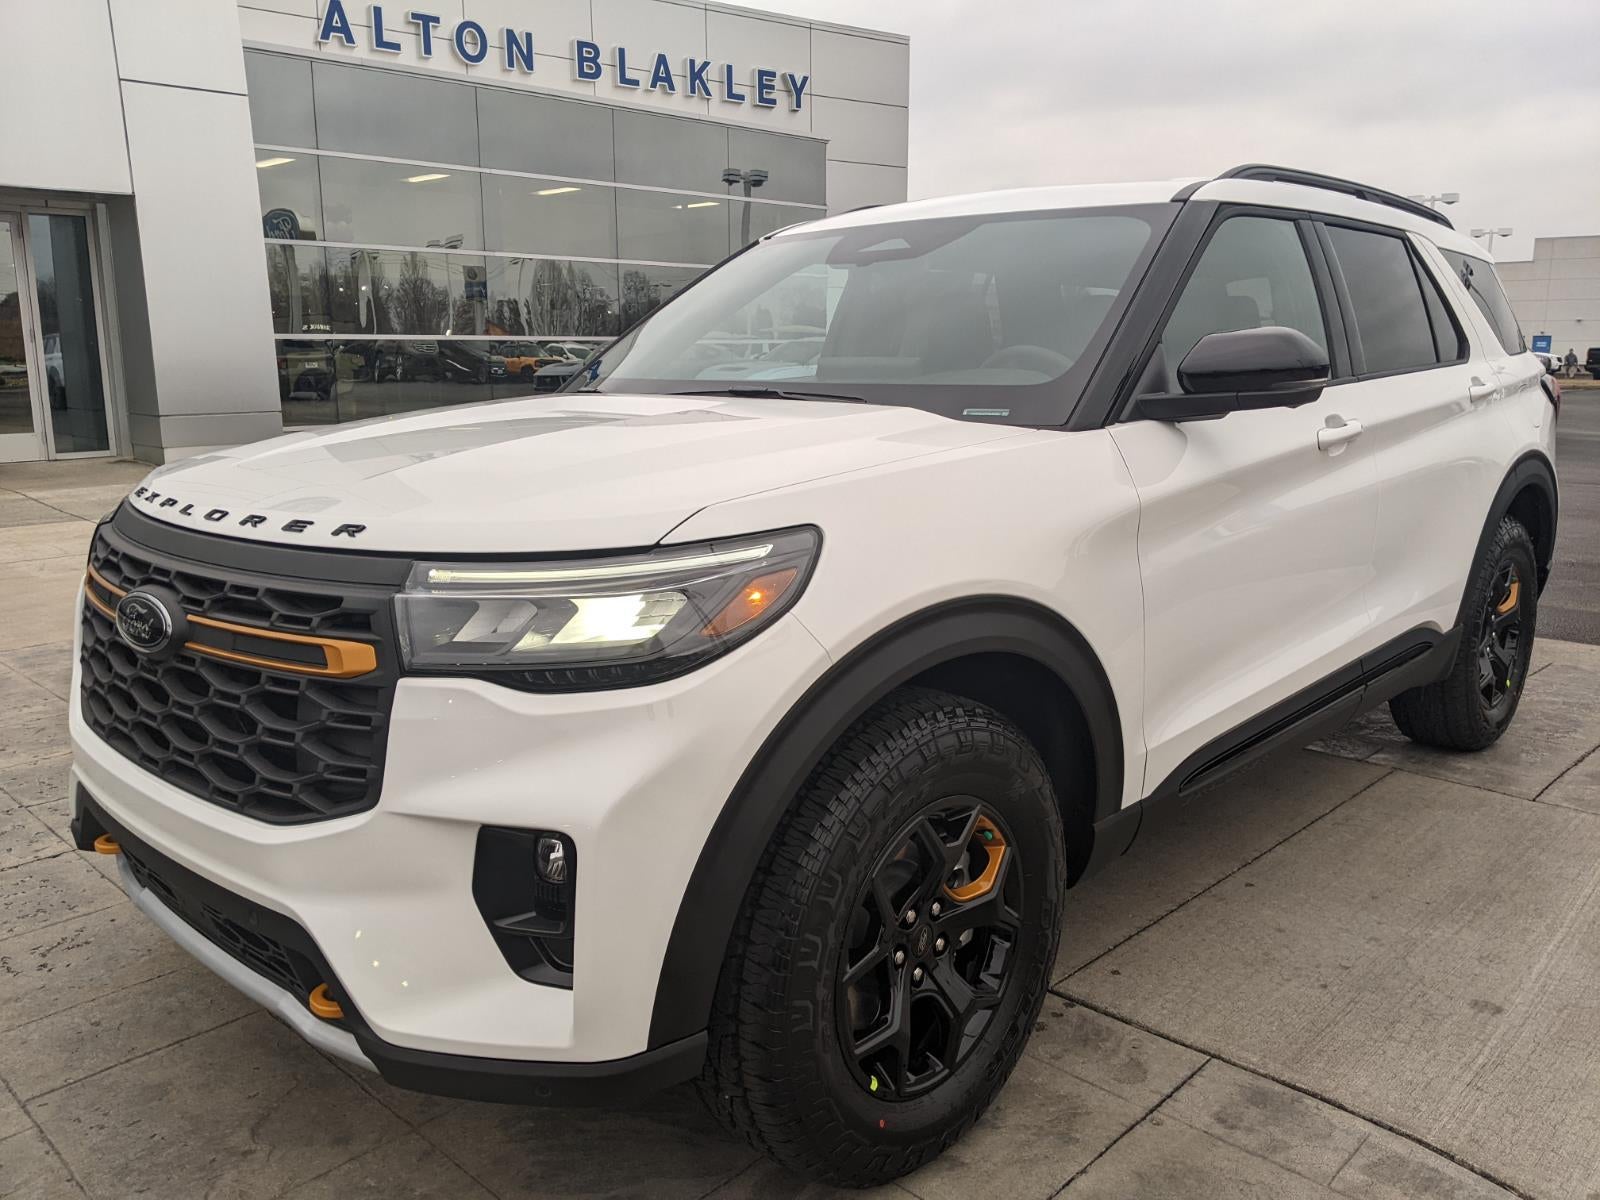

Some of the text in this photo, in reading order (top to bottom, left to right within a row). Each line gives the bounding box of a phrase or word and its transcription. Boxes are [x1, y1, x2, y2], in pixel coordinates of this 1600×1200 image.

[318, 0, 810, 111] ALTON BLAKLEY
[133, 486, 367, 538] EXPLORER
